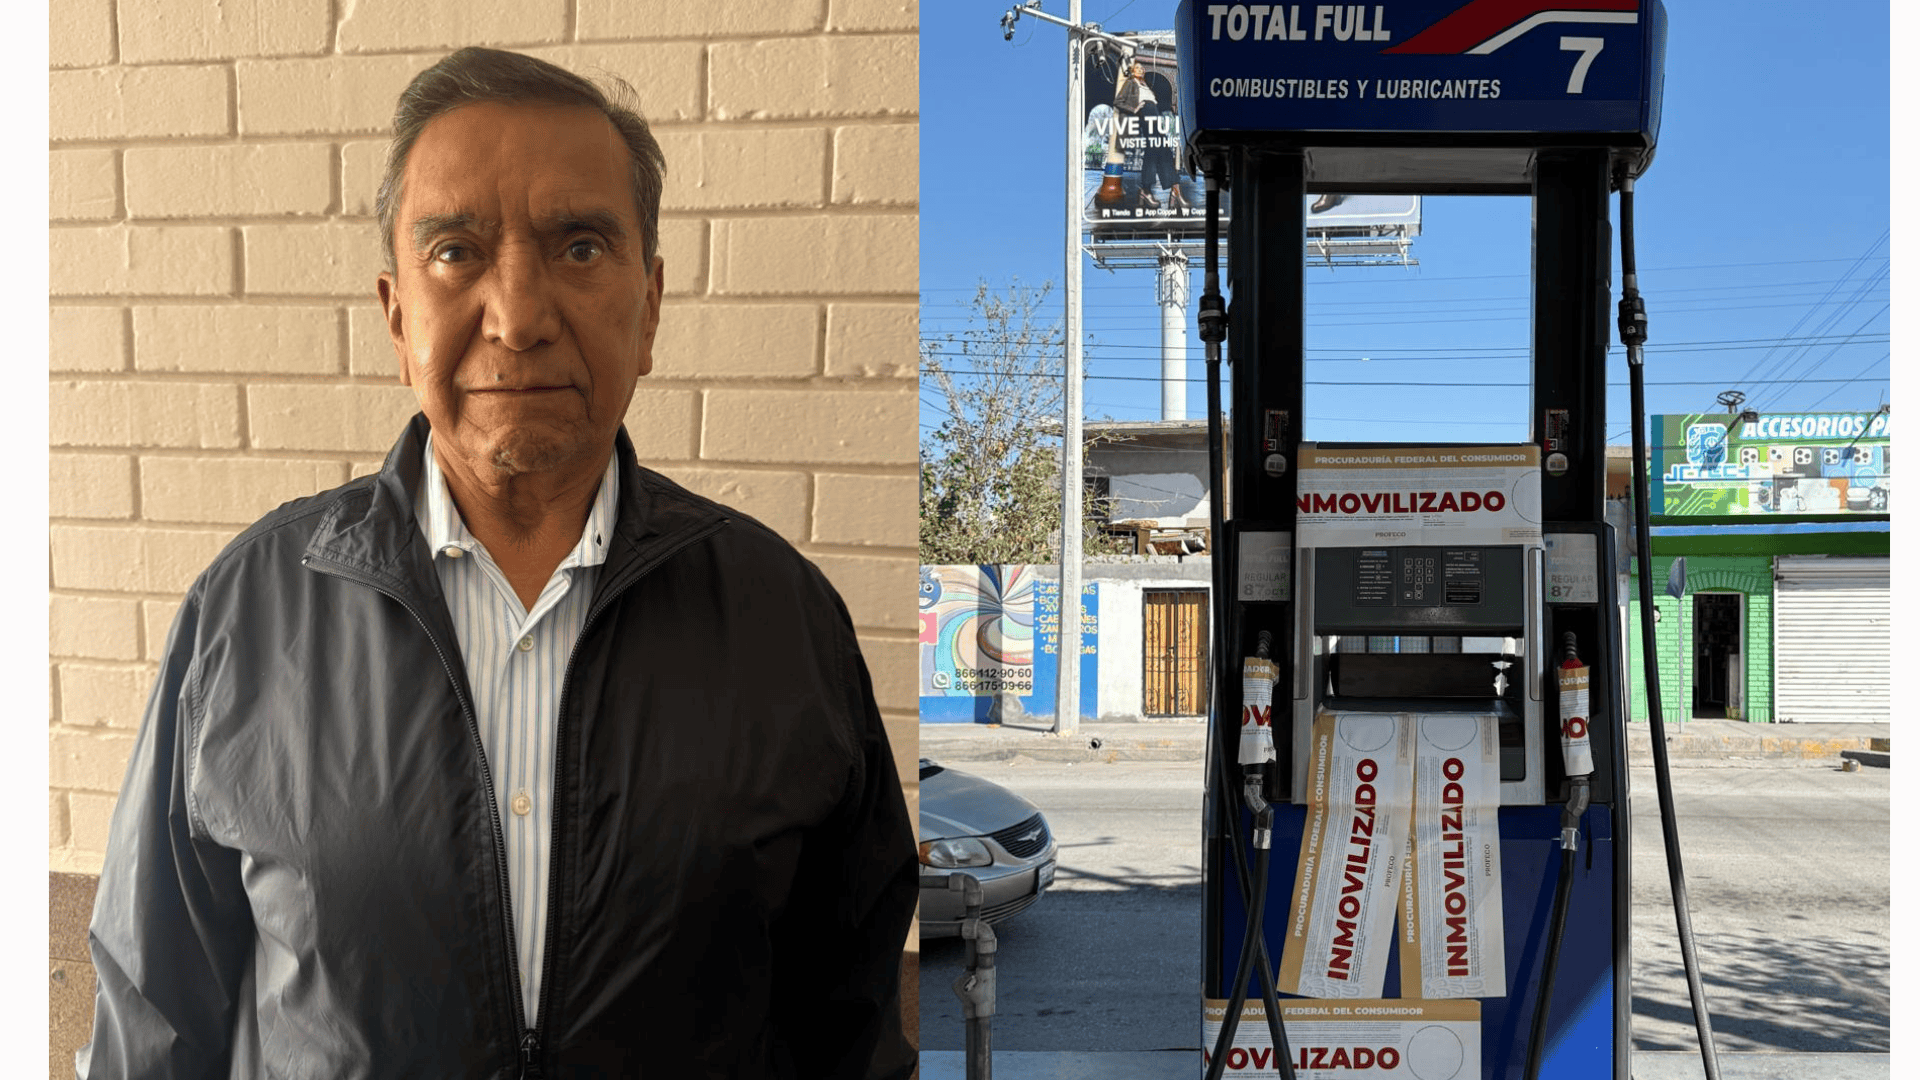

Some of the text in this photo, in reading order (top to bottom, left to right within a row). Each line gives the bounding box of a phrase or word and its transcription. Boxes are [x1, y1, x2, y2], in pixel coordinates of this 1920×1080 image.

[1207, 5, 1391, 42] TOTAL FULL
[1559, 36, 1605, 95] 7
[1209, 78, 1500, 99] COMBUSTIBLES Y LUBRICANTES
[1094, 116, 1140, 135] VIVE
[1144, 115, 1170, 135] TU
[1120, 138, 1147, 148] VISTE
[1149, 138, 1161, 148] TU
[1742, 415, 1864, 438] ACCESORIOS
[1315, 454, 1527, 464] PROCURADURÍA FEDERAL DEL CONSUMIDOR
[1551, 585, 1573, 597] 87
[1294, 734, 1328, 937] PROCURADURÍA FEDERAL CONSUMIDOR
[1327, 758, 1378, 981] INMOVILIZADO
[1404, 861, 1415, 943] PROCURADURÍA
[1285, 1007, 1331, 1016] FEDERAL
[1333, 1007, 1352, 1016] DEL
[1355, 1007, 1423, 1016] CONSUMIDOR
